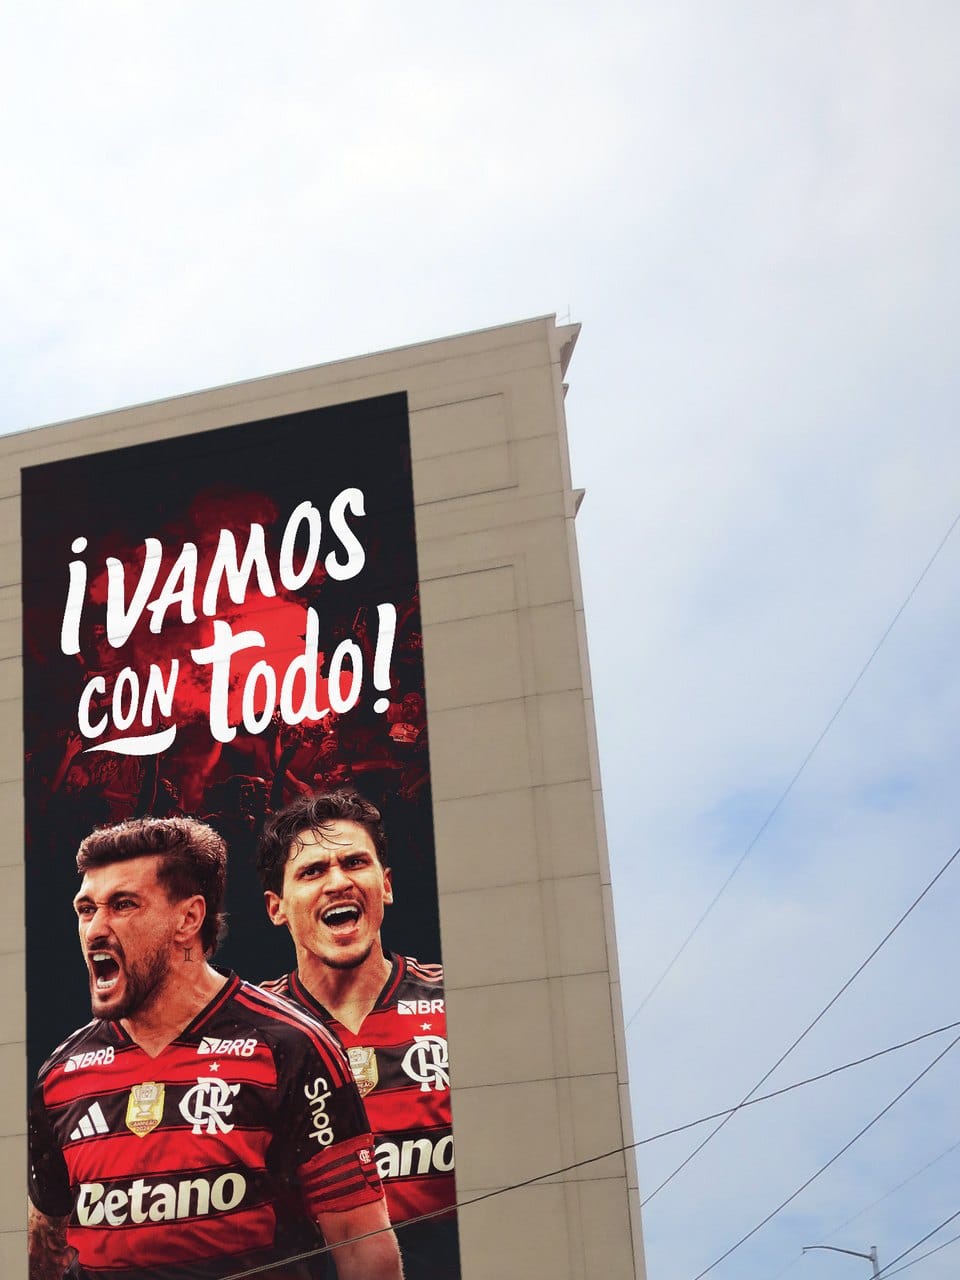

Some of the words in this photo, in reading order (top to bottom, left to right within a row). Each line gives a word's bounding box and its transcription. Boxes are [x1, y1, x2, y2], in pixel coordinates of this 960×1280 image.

[60, 487, 367, 656] ¡VAMOS
[77, 658, 180, 740] CON
[80, 1045, 116, 1068] BRB
[215, 1038, 258, 1057] BRB
[303, 1076, 335, 1151] Shop
[373, 1134, 456, 1179] ano
[76, 1171, 247, 1227] Betano
